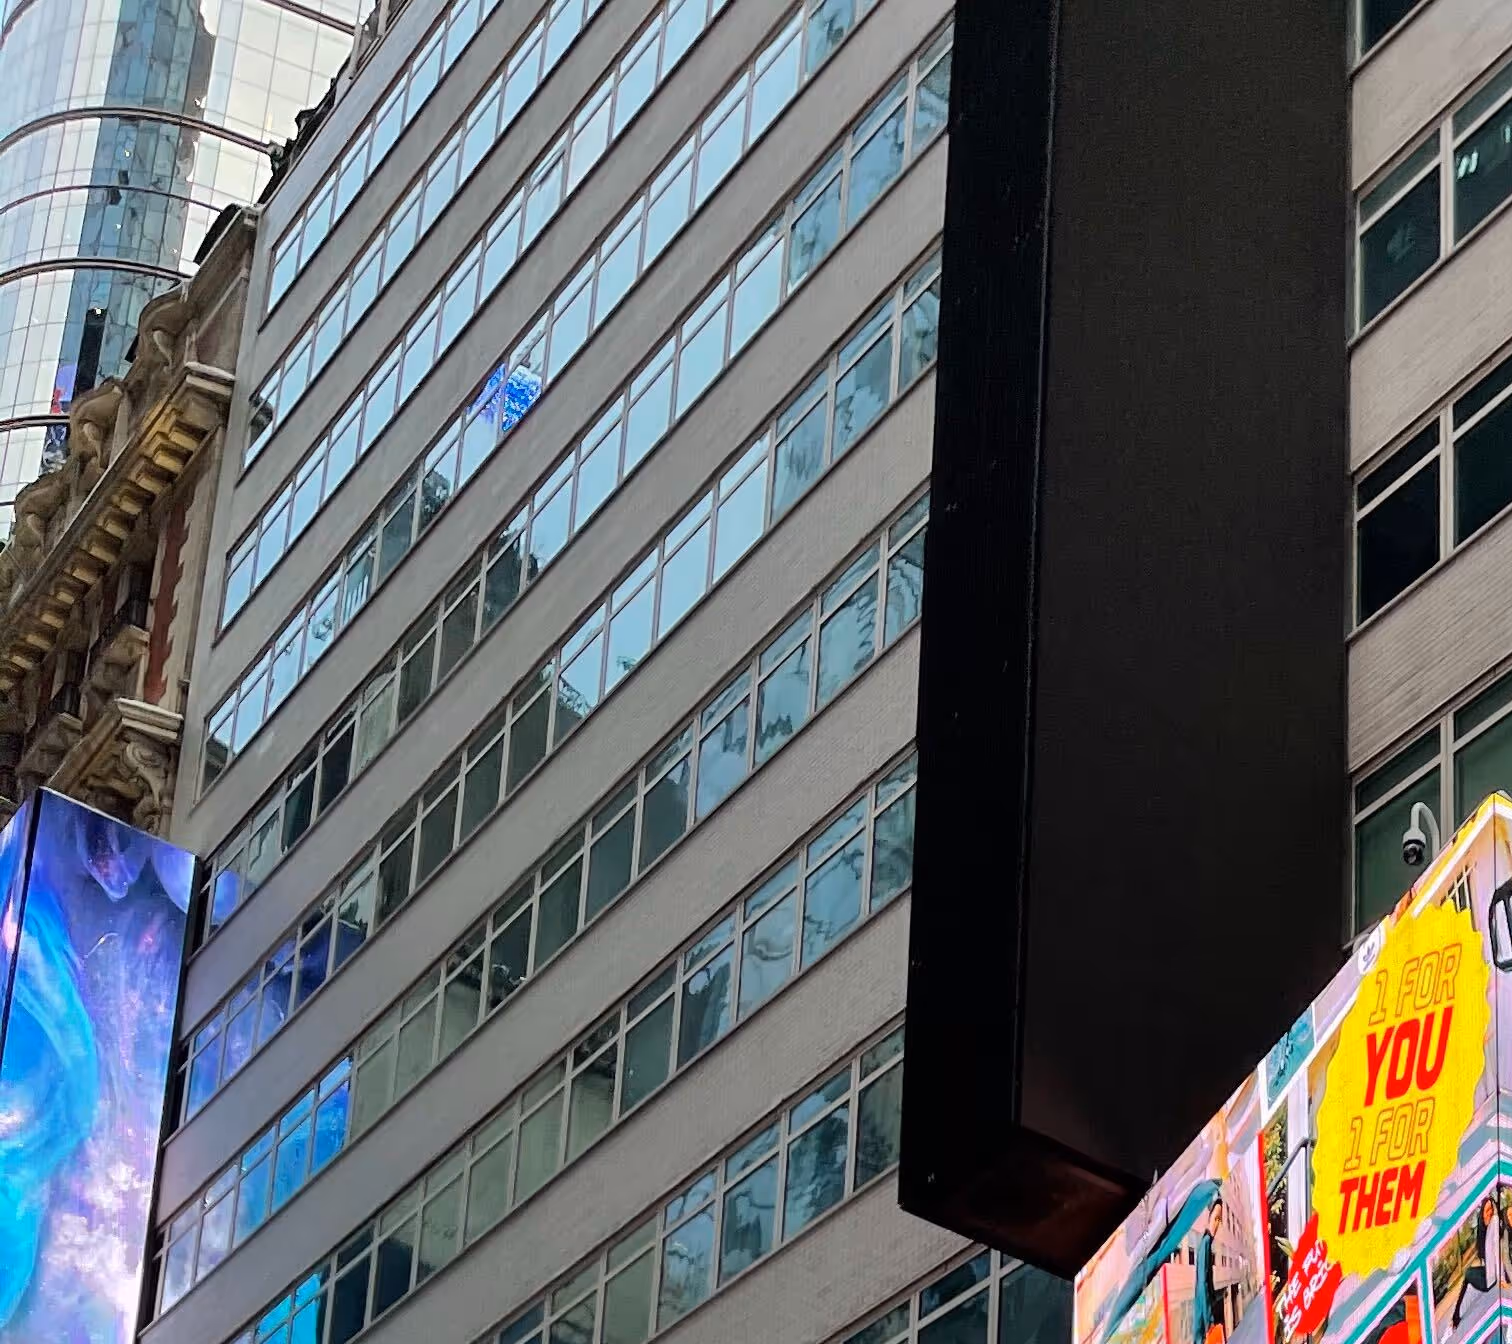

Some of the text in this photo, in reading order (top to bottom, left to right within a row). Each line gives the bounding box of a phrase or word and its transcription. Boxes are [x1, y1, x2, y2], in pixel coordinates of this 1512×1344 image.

[1368, 943, 1461, 1026] 1 FOR
[1364, 1005, 1454, 1107] YOU
[1344, 1097, 1435, 1172] 1 FOR
[1338, 1160, 1426, 1235] THEM
